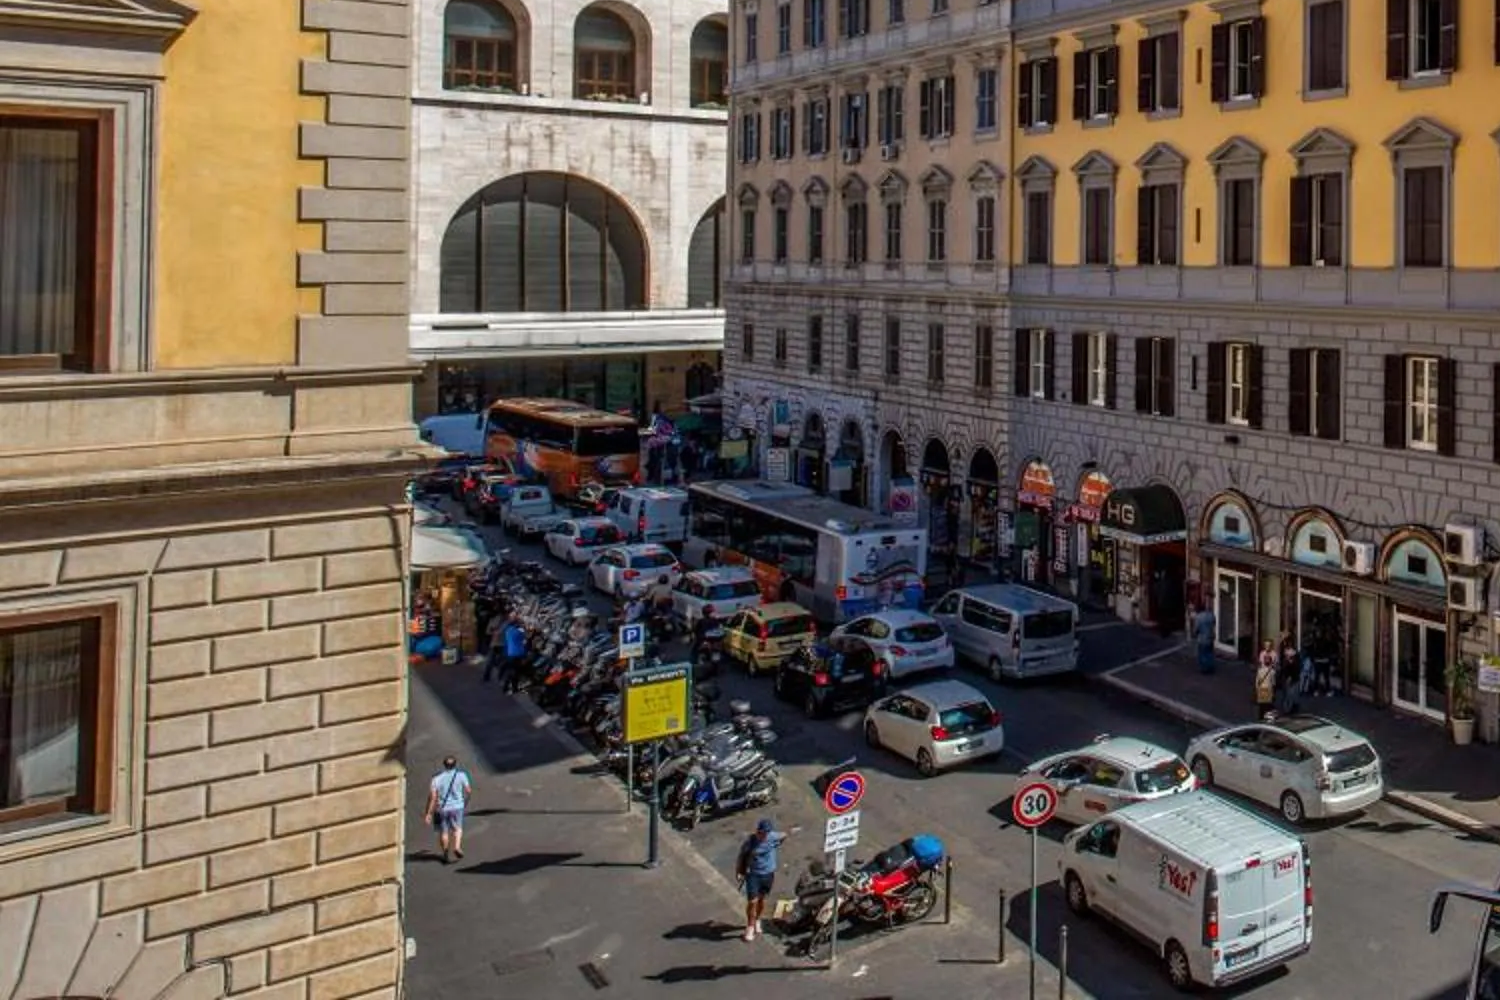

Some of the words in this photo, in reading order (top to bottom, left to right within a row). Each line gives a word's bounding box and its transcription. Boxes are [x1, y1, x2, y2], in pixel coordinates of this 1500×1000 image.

[1107, 501, 1135, 525] HG
[626, 629, 637, 641] P
[1023, 793, 1047, 815] 30
